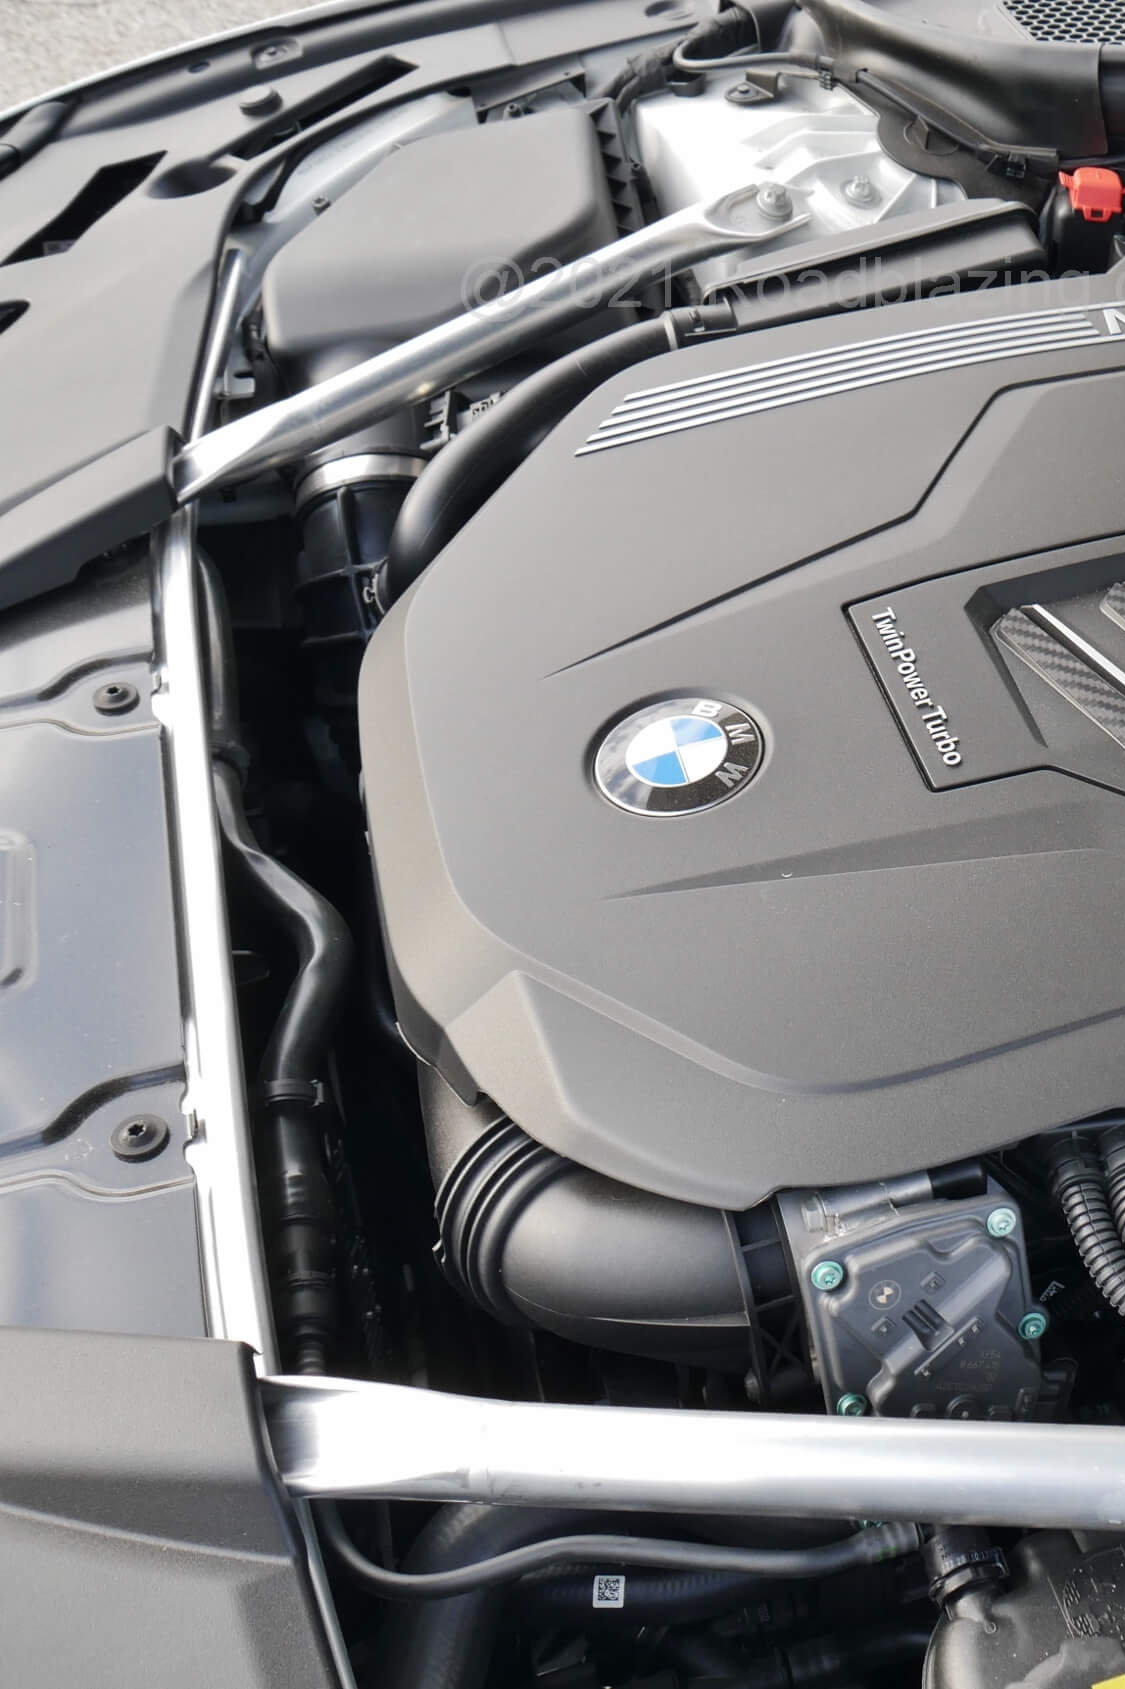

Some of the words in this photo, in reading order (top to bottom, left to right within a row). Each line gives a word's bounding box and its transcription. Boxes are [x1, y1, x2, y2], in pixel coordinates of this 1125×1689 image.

[691, 701, 756, 788] BMW
[872, 607, 933, 708] TwinPower
[922, 706, 962, 766] Turbo
